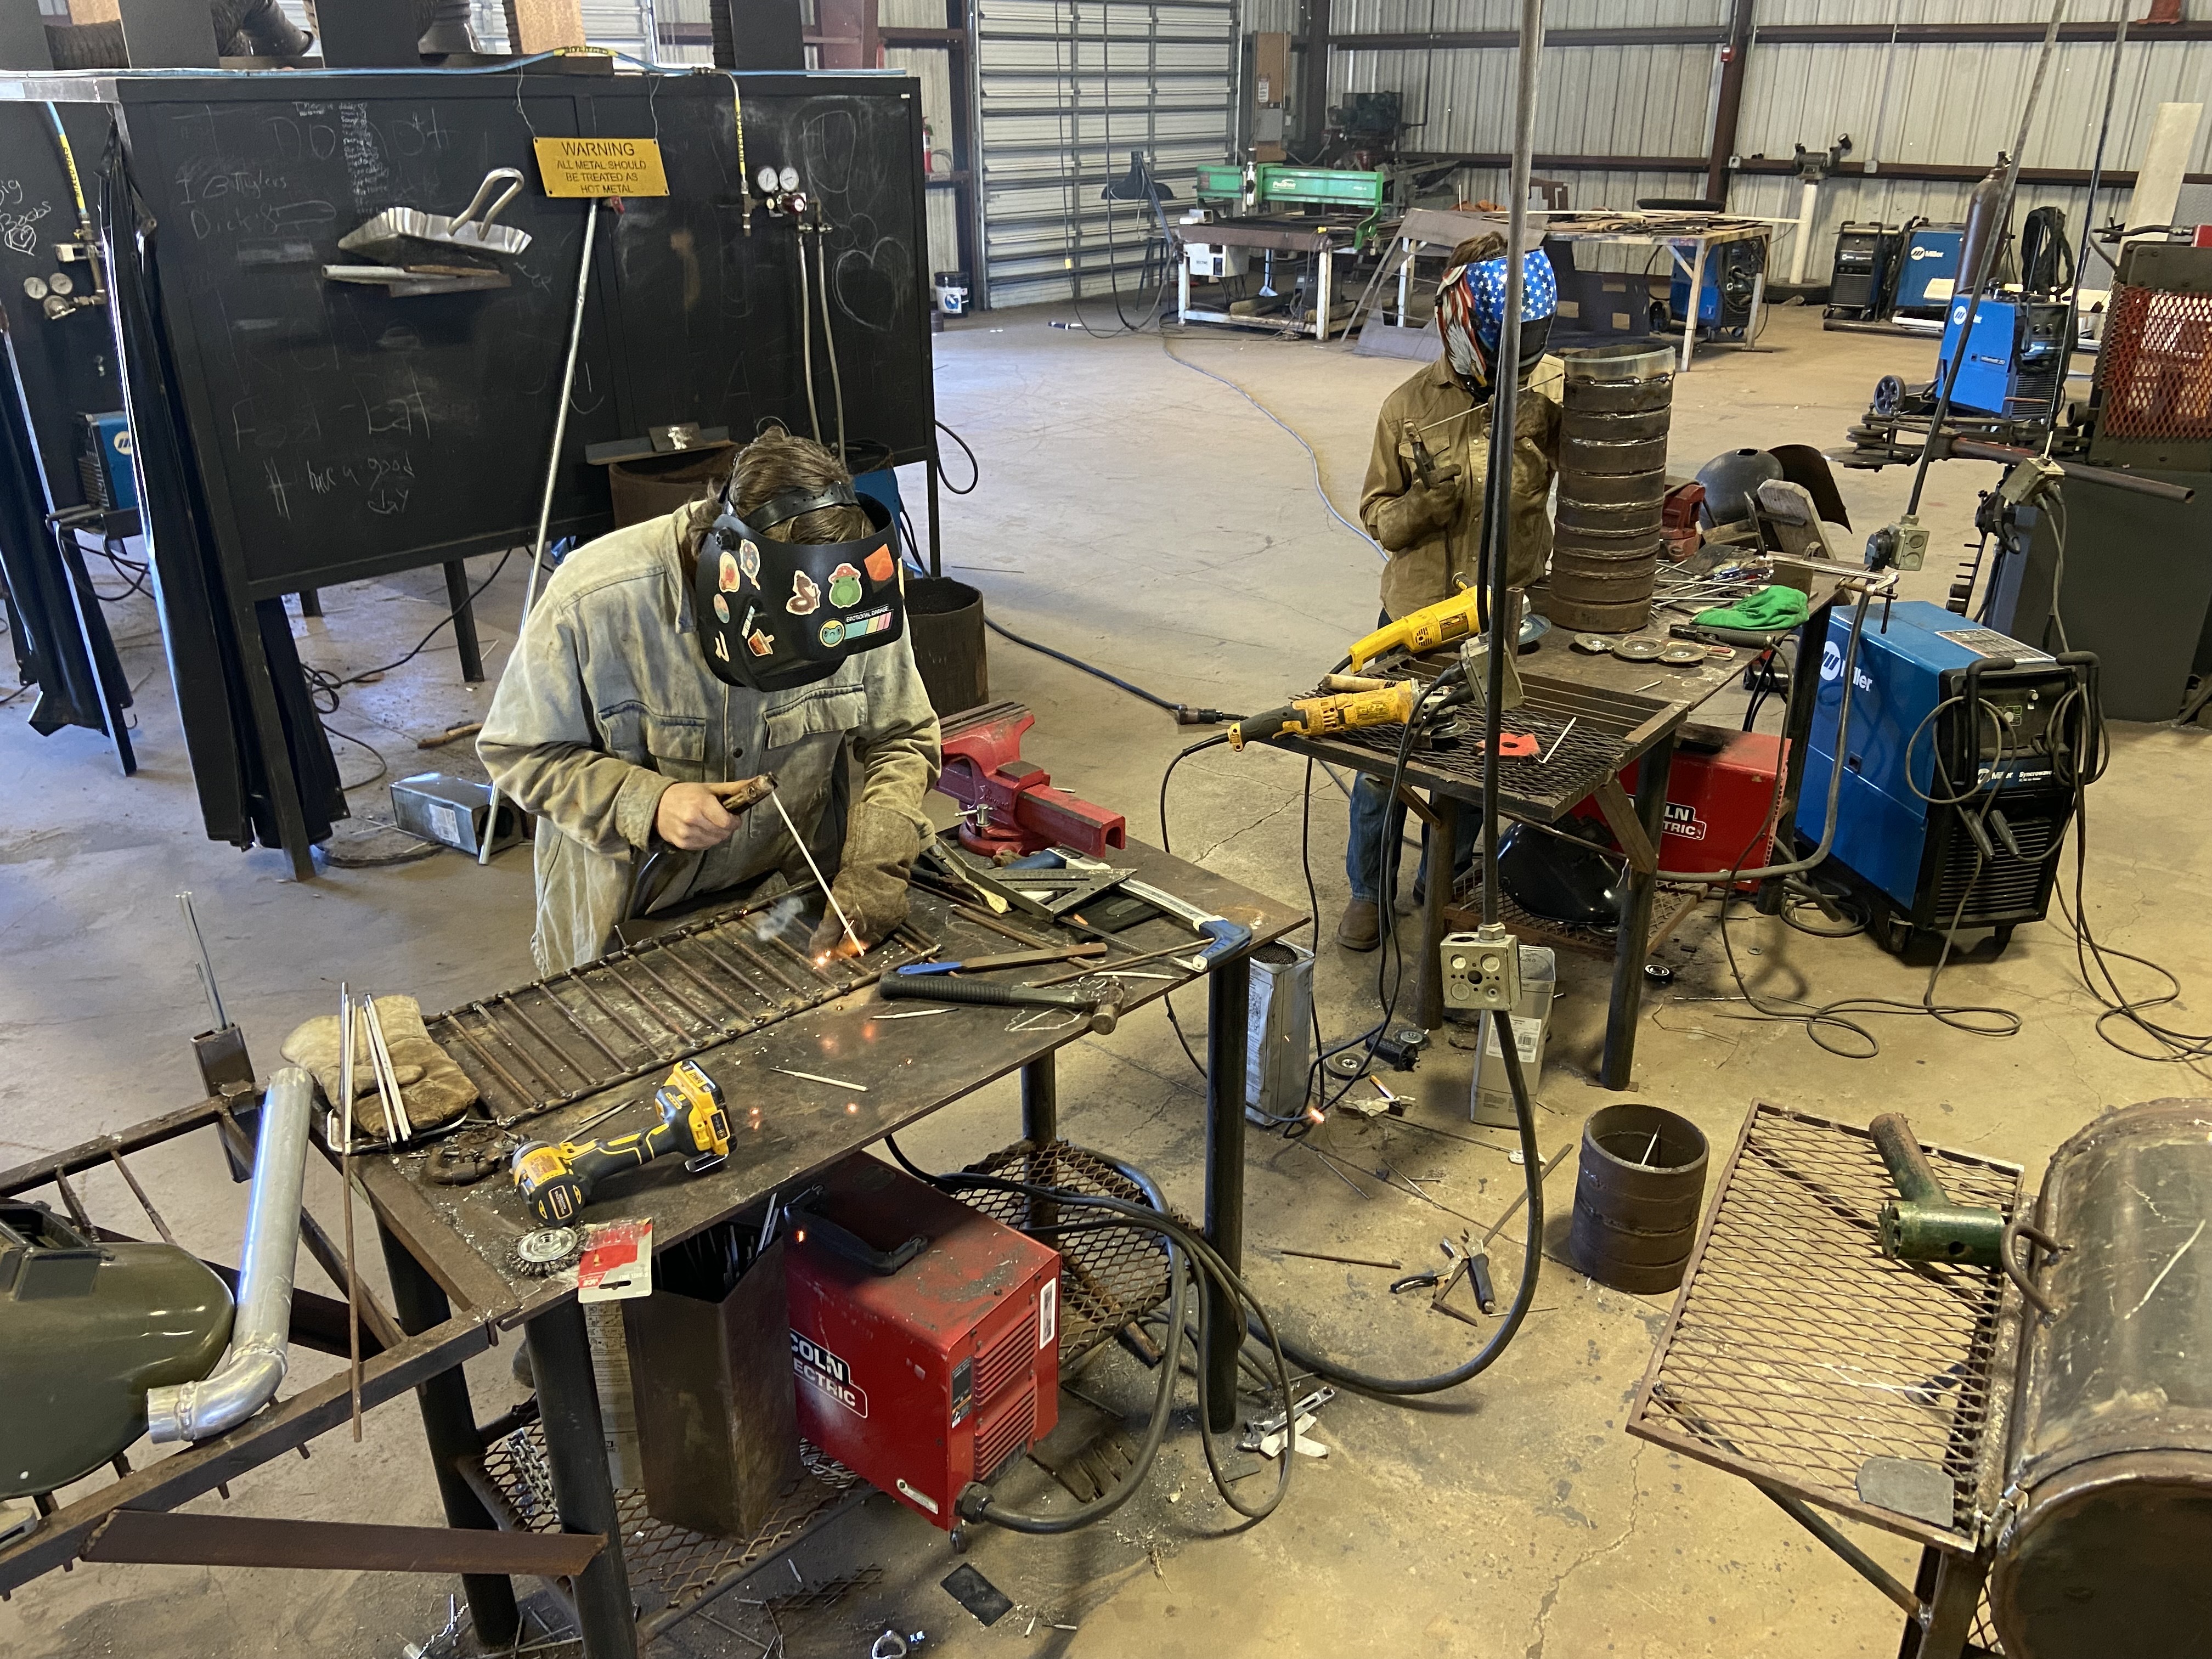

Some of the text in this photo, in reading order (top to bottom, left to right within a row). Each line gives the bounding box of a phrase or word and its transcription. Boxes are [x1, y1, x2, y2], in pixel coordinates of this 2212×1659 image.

[561, 141, 635, 156] WARNING
[557, 160, 646, 170] ALL METAL SHOULD
[566, 173, 638, 182] BE TREATED AS
[602, 185, 634, 194] METAL
[2018, 770, 2052, 778] Syncrowave
[1663, 821, 1696, 836] TRIC
[790, 1333, 843, 1381] COLN
[793, 1357, 856, 1407] ECTRIC
